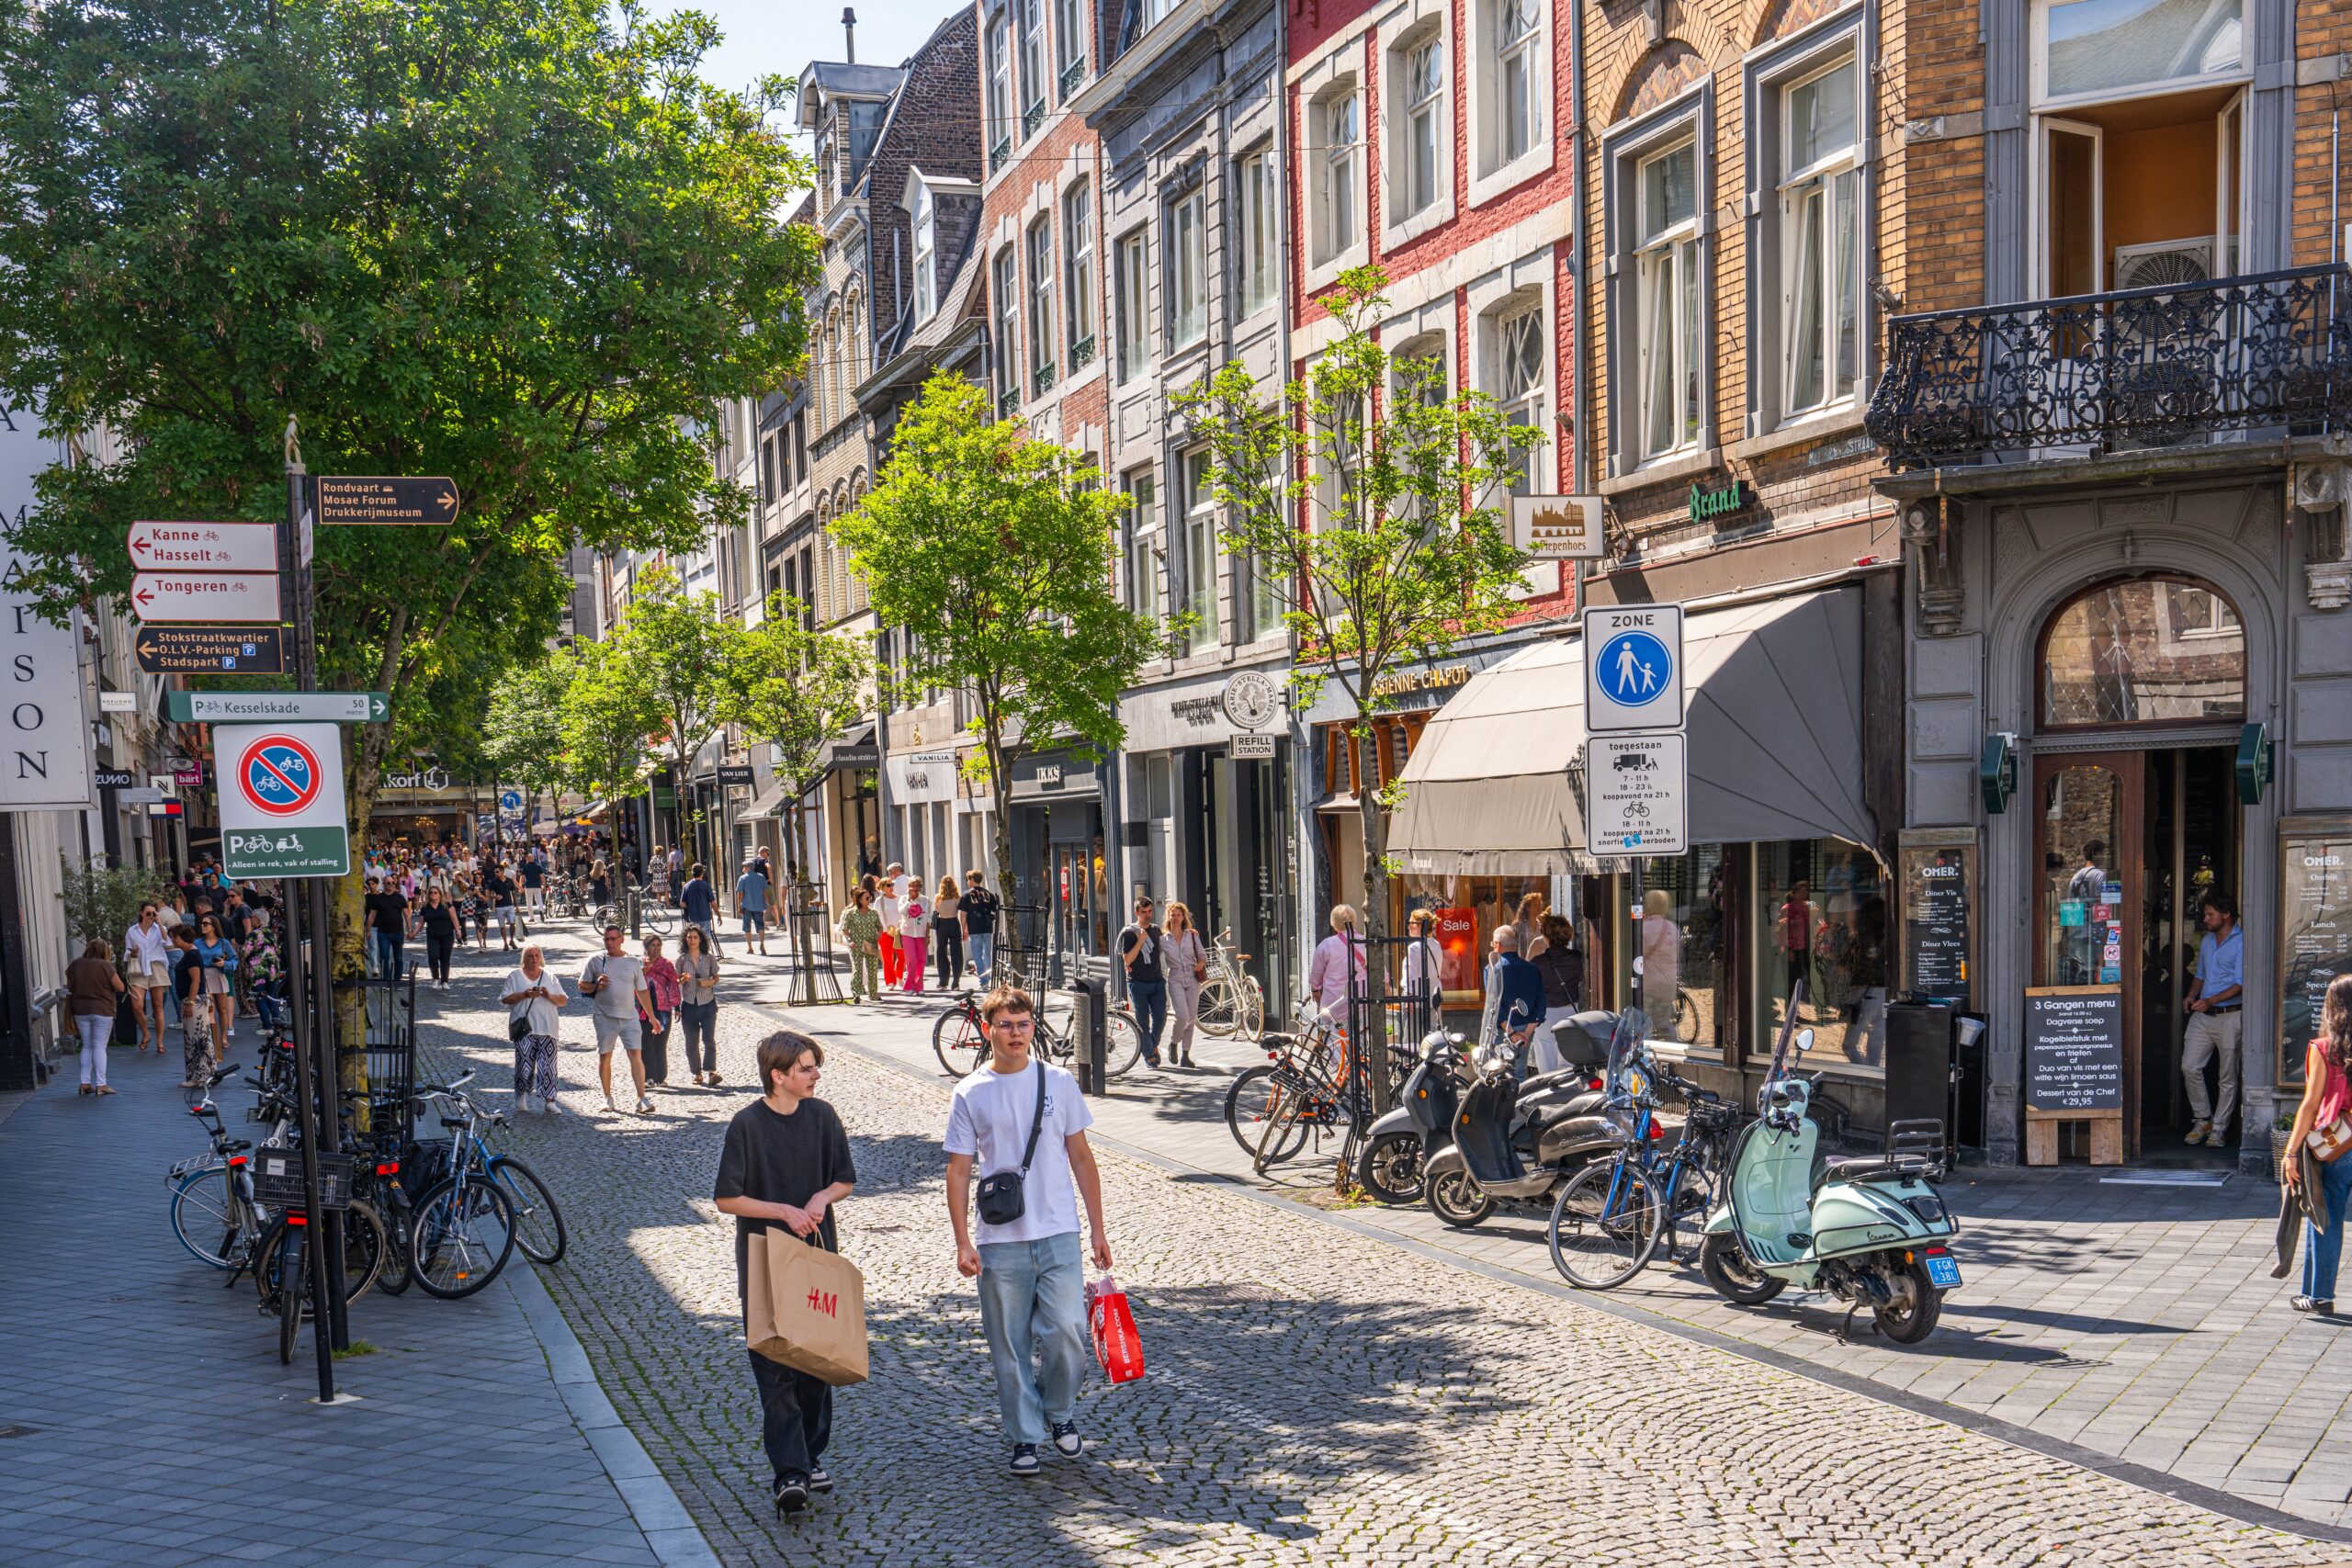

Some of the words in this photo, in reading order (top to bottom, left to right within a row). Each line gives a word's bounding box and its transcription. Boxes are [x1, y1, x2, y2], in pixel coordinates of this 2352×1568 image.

[322, 482, 379, 493] Rondvaart
[322, 494, 359, 505] Mosae
[362, 494, 397, 505] Forum
[1690, 479, 1742, 525] Brand
[323, 506, 423, 519] Drukkerijmuseum
[153, 527, 199, 542] Kanne
[1540, 538, 1587, 554] Piepenhoes
[153, 548, 212, 562] Hasselt
[154, 579, 229, 596] Tongeren
[1611, 614, 1655, 627] ZONE
[158, 631, 270, 644] Stokstraatkwartier
[159, 644, 240, 657] O.L.V.-Parking
[160, 656, 220, 670] Stadspark
[1373, 672, 1417, 695] ABIENNE
[1421, 664, 1467, 689] CHAPOT
[224, 701, 300, 714] Kesselskade
[353, 699, 364, 708] 50
[1238, 737, 1272, 746] REFILL
[1609, 741, 1662, 752] toegestaan
[1238, 746, 1272, 754] STATION
[95, 774, 130, 784] ZUMO
[1036, 764, 1060, 784] IKKS
[379, 773, 421, 788] korf
[1603, 829, 1642, 837] koopavond
[1598, 838, 1634, 846] snorfie
[232, 860, 256, 869] Alleen
[258, 860, 266, 868] in
[267, 859, 283, 869] rek,
[284, 859, 298, 867] vak
[299, 858, 309, 866] of
[310, 857, 339, 867] stalling
[2310, 874, 2338, 882] Ontbijt
[1442, 919, 1470, 931] Sale
[2306, 981, 2330, 990] Speci
[2035, 1001, 2041, 1010] 3
[2043, 1000, 2085, 1011] Gangen
[2086, 999, 2116, 1009] menu
[2085, 1017, 2105, 1025] soep
[2039, 1034, 2090, 1043] Kogelbiefstuk
[2092, 1033, 2108, 1042] met
[2054, 1074, 2069, 1082] wijn
[2071, 1073, 2098, 1081] limoen
[2096, 1088, 2116, 1096] Chef
[1936, 1260, 1954, 1270] FGK
[807, 1286, 838, 1320] H&M
[1113, 1307, 1131, 1364] BERSHKA.COM
